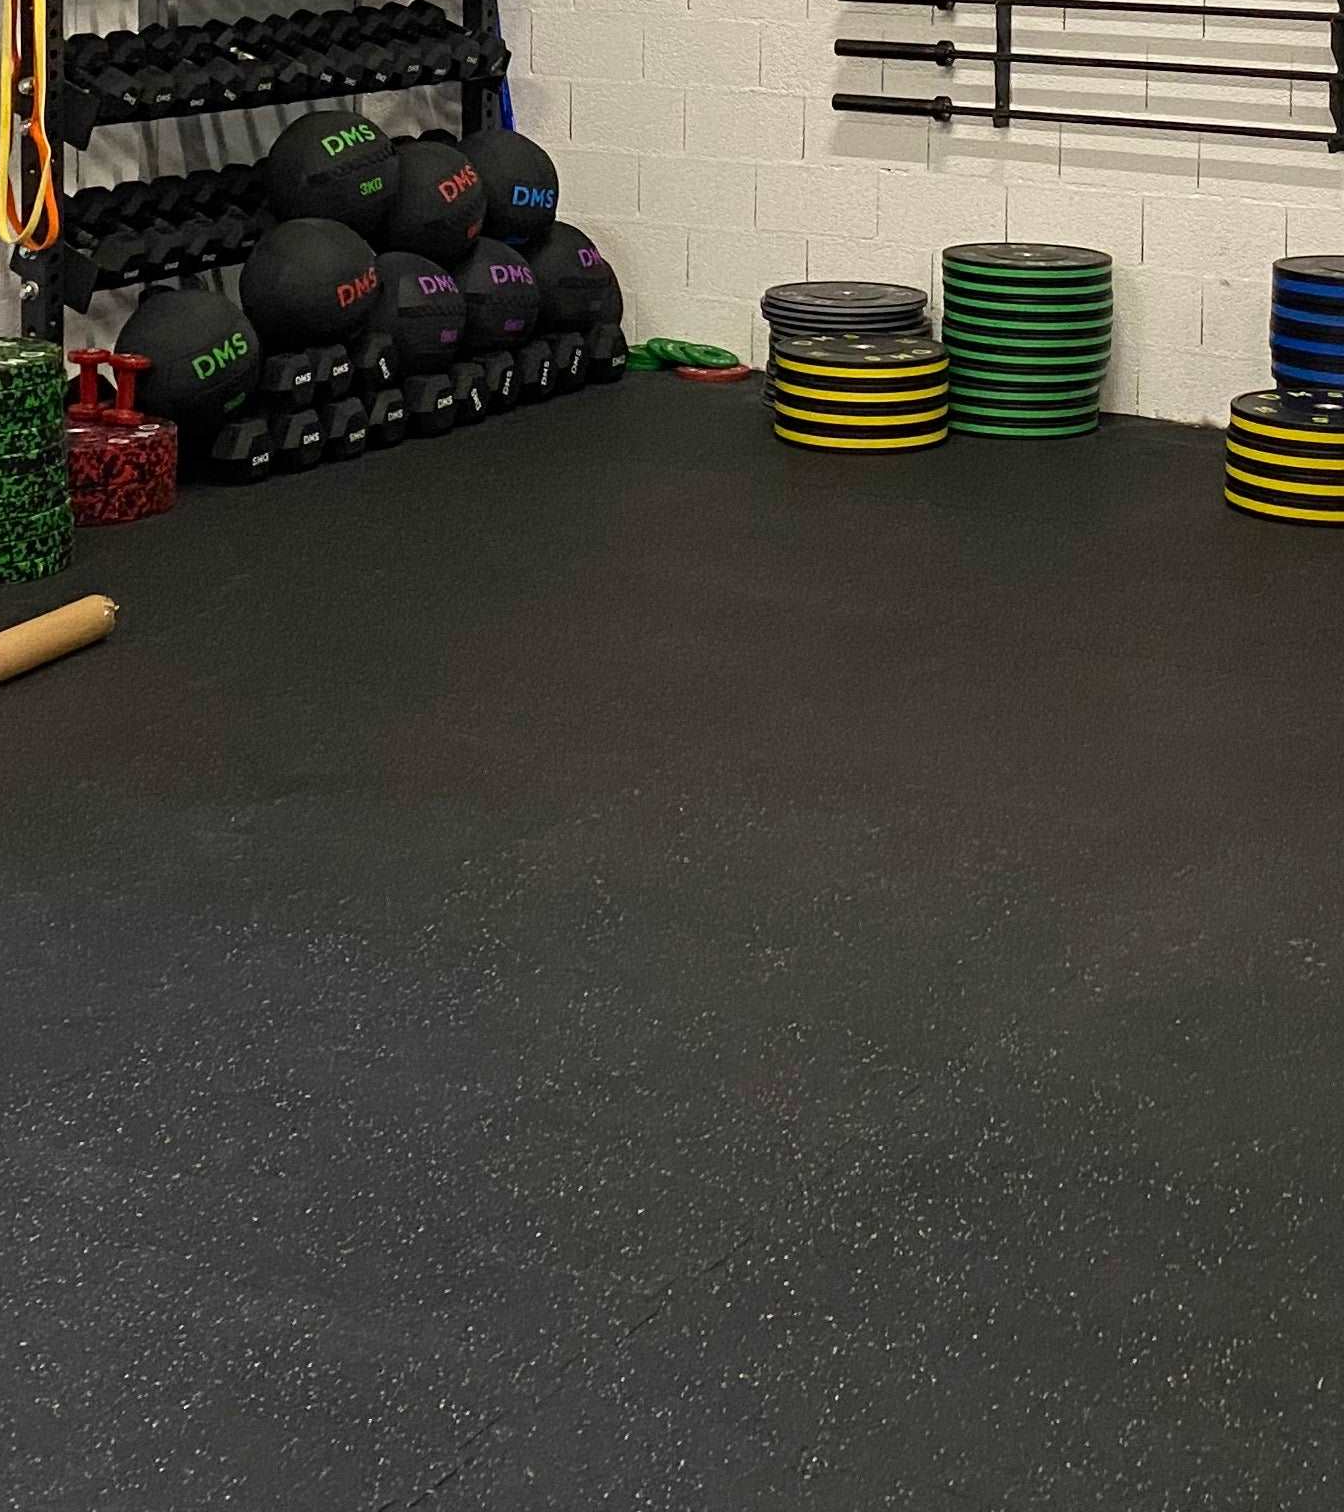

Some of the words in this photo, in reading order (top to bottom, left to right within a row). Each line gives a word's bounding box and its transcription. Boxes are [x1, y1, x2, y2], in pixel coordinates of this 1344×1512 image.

[321, 123, 377, 156] DMS
[437, 163, 479, 203] DMS
[511, 183, 555, 208] DMS
[336, 266, 378, 308] DMS
[488, 263, 534, 286] DMS
[191, 332, 249, 380] DMS
[332, 362, 349, 378] DMS
[295, 372, 312, 386] DMS
